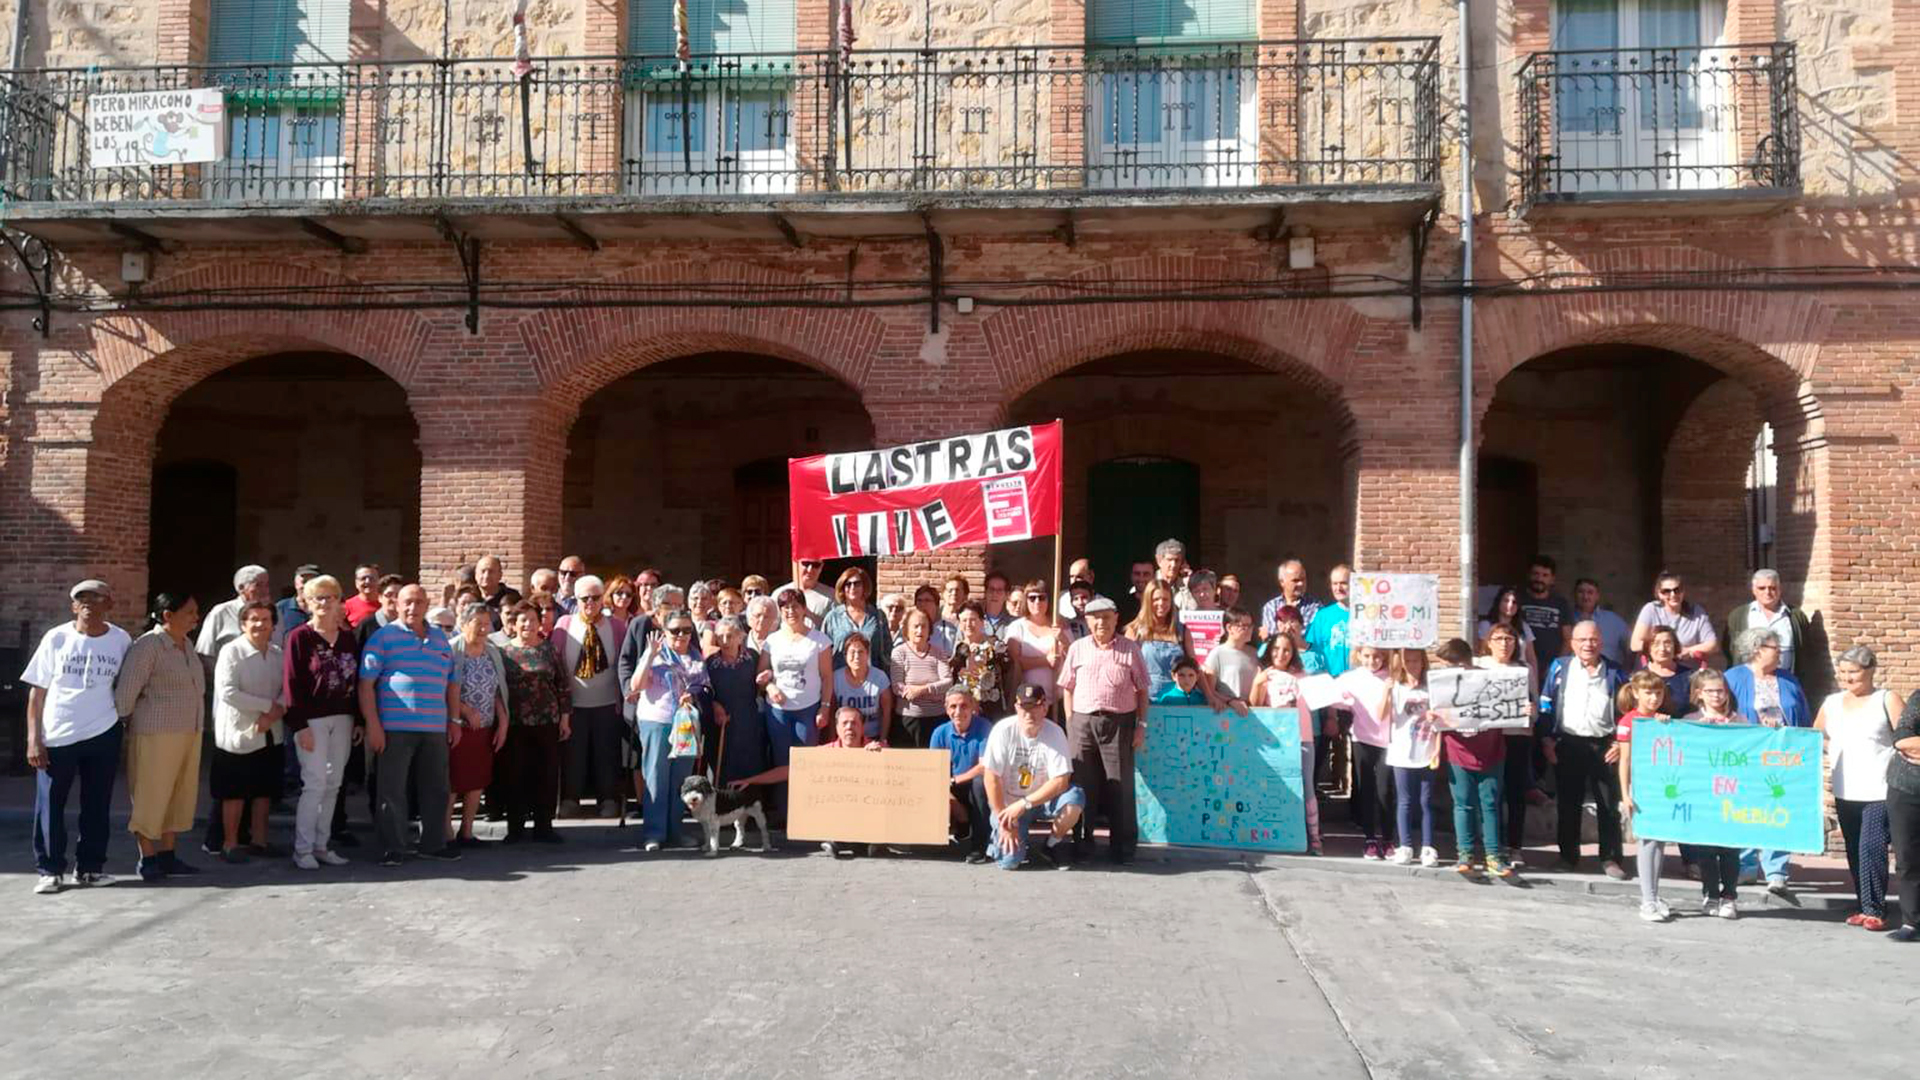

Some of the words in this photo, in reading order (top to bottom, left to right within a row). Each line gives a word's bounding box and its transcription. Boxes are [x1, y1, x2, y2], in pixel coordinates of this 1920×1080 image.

[93, 96, 126, 113] PERO
[94, 115, 133, 132] BEBEN
[95, 136, 117, 150] LOS
[831, 429, 1032, 494] LASTRAS
[835, 501, 952, 555] VIVE
[1357, 576, 1391, 594] YO
[1708, 747, 1748, 768] VIDA
[1713, 775, 1738, 796] EN
[1672, 802, 1692, 823] MI
[1201, 829, 1280, 843] LSRAS
